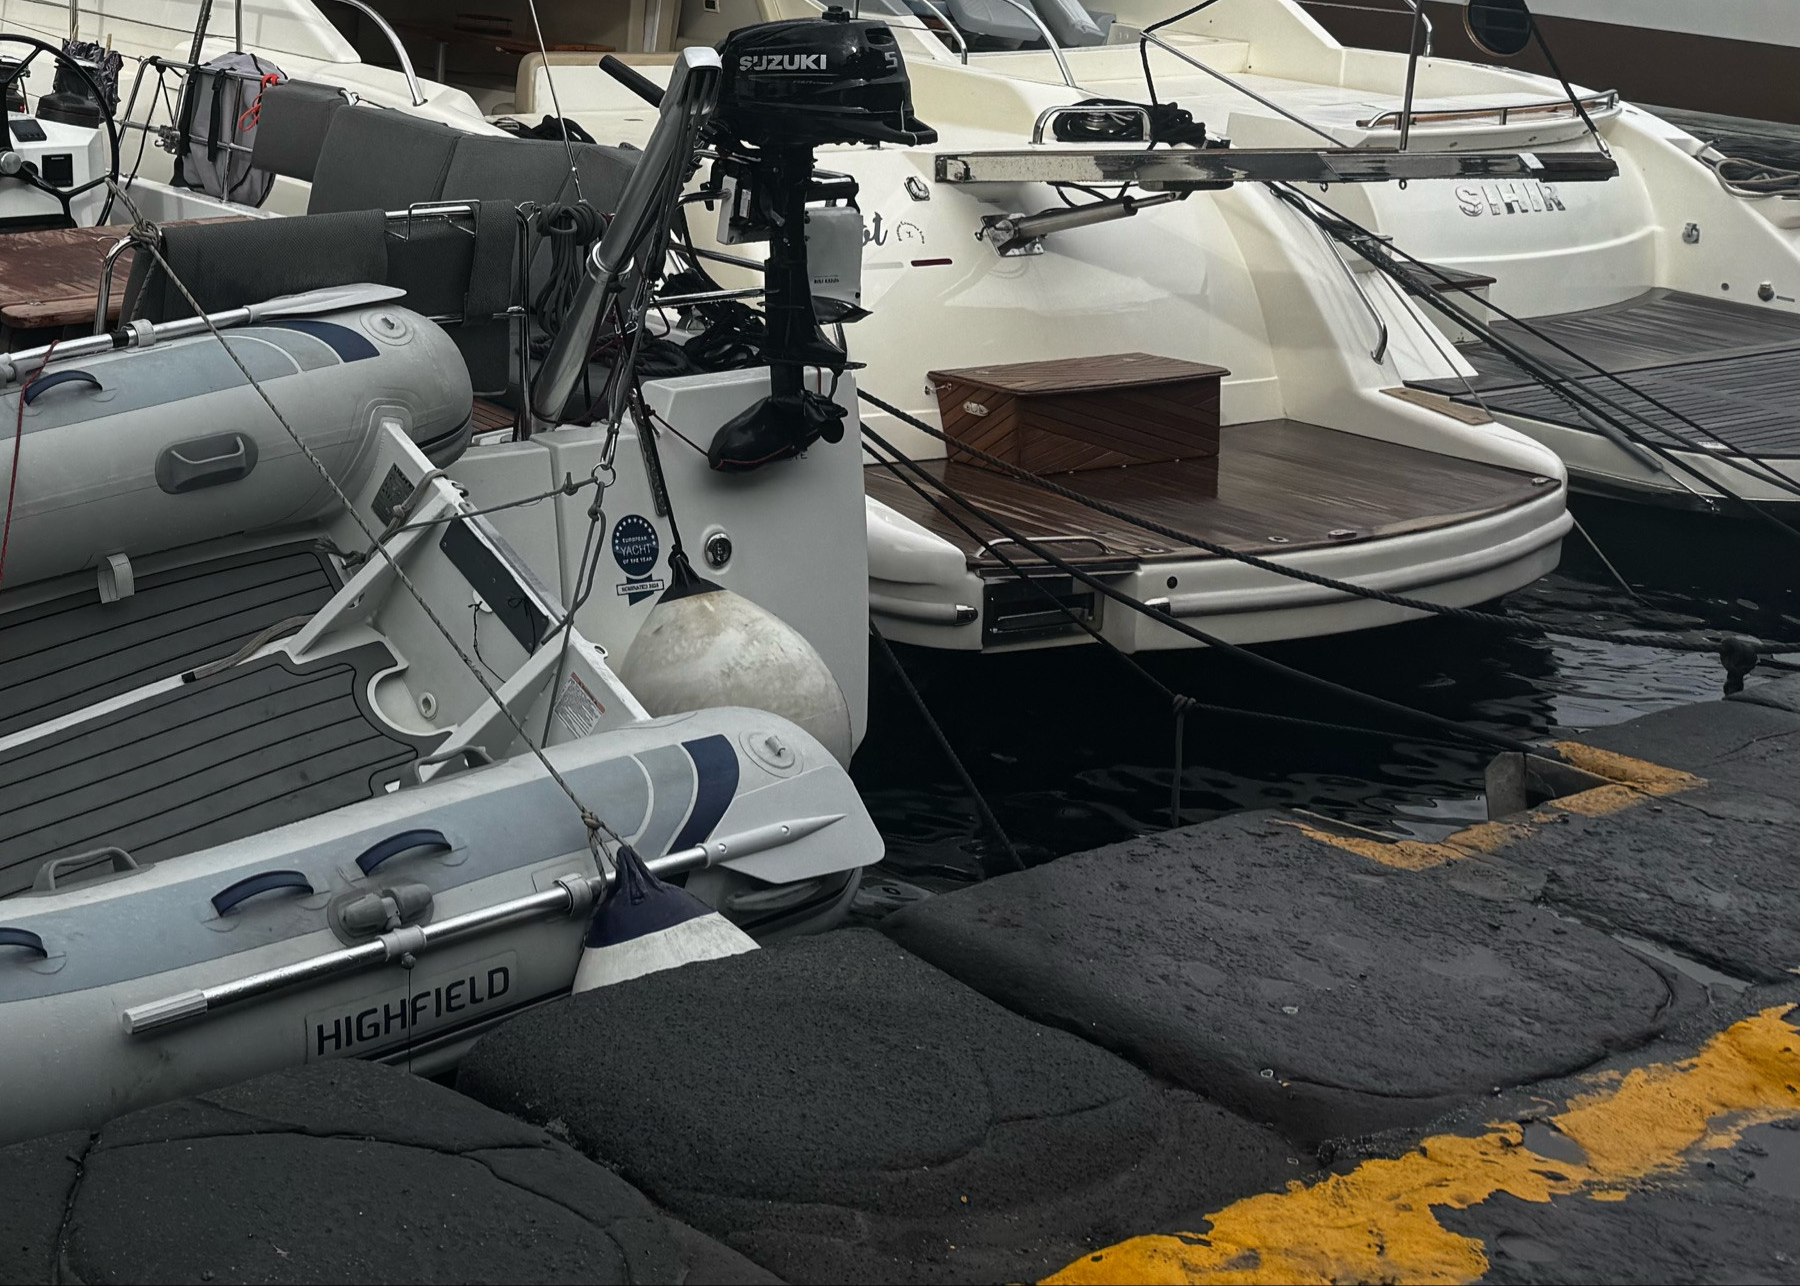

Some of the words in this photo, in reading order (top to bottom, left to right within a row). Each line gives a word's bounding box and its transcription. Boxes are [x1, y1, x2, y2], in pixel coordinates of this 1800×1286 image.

[739, 54, 827, 71] SUZUKI
[884, 51, 898, 69] 5
[620, 543, 652, 556] YACHT
[317, 967, 510, 1056] HIGHFIELD
